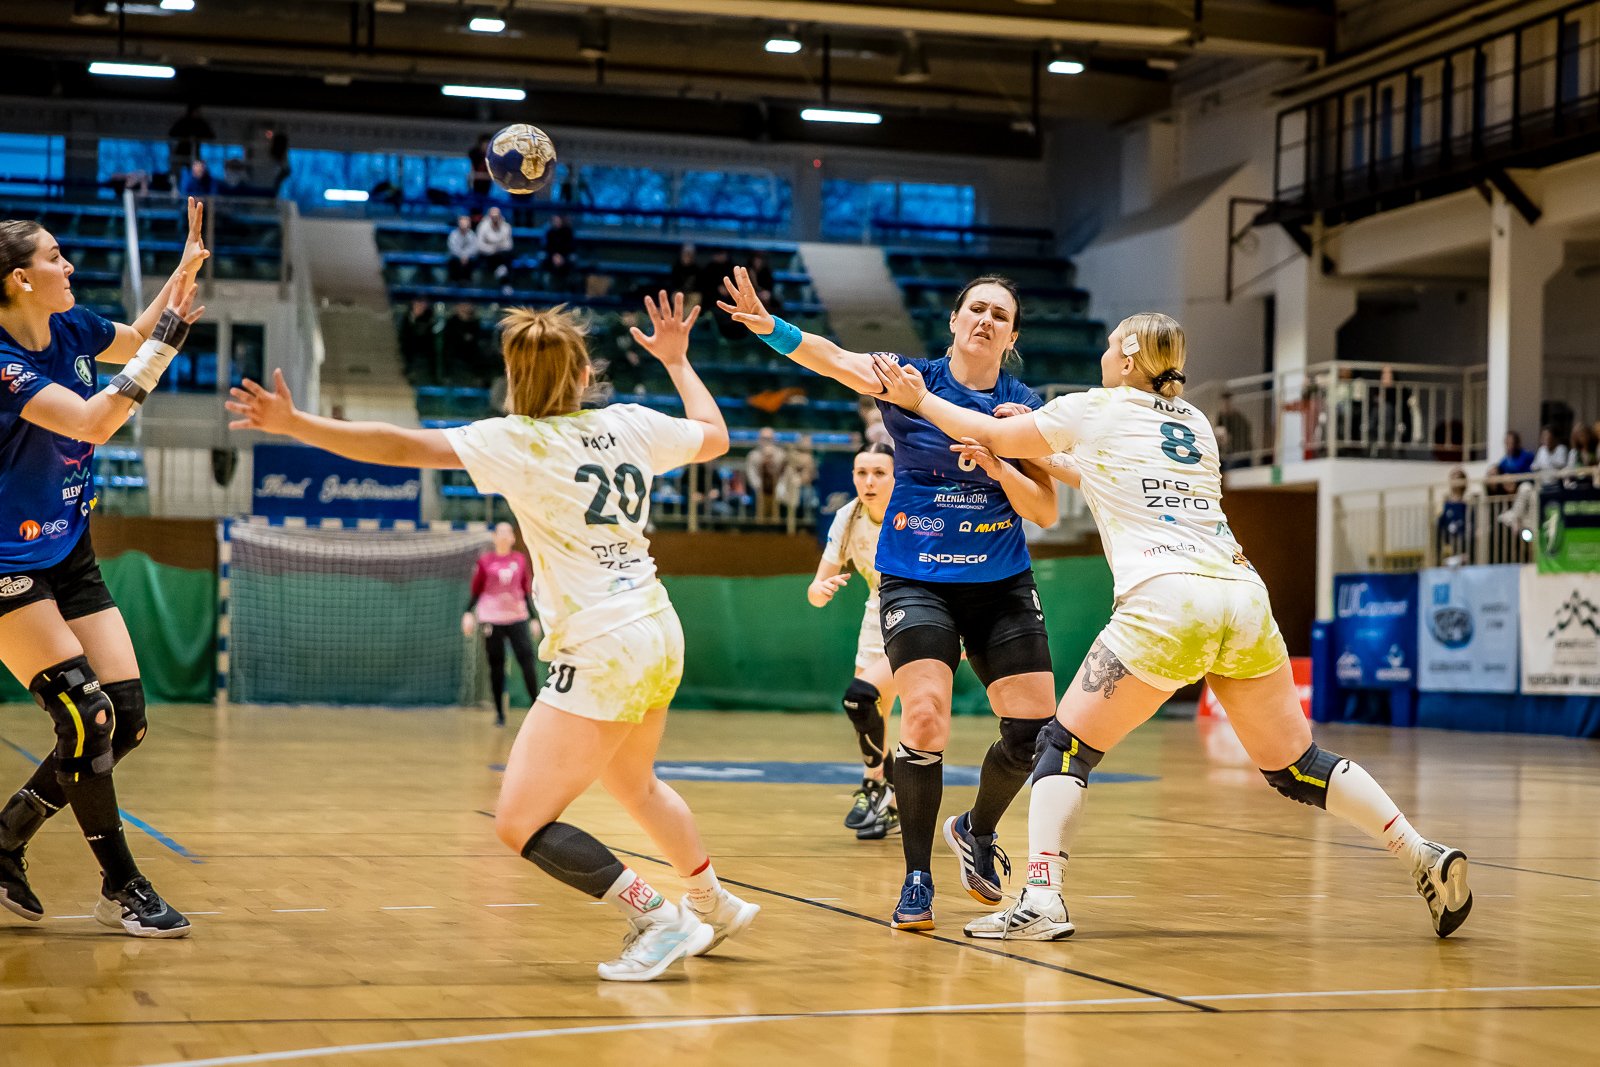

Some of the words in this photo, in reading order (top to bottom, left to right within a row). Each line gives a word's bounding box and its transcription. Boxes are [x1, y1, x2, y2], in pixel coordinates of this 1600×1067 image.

[1160, 422, 1202, 465] 8
[575, 463, 646, 525] 20
[1141, 479, 1190, 494] pre
[934, 493, 965, 503] JELENIA
[1145, 496, 1209, 510] zero
[907, 515, 945, 532] eco
[919, 553, 988, 564] ENDEGO
[544, 663, 576, 693] 0
